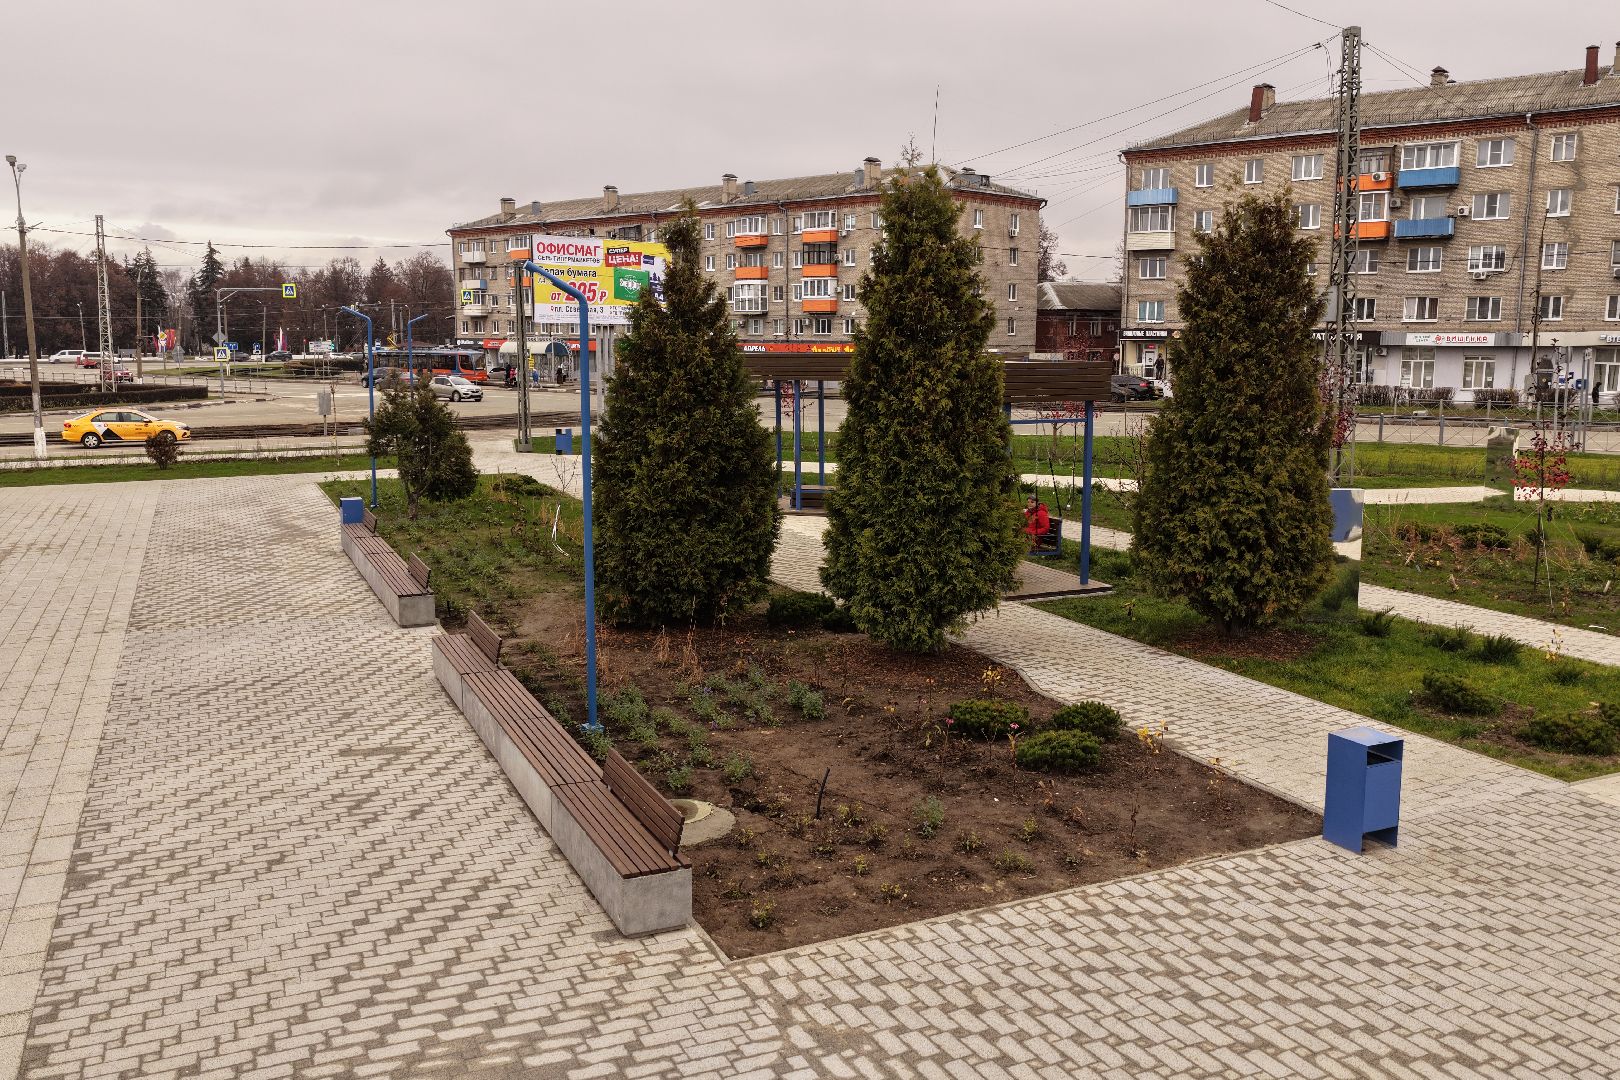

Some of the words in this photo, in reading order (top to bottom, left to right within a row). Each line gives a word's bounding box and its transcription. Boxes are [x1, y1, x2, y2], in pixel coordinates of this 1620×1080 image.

[536, 241, 601, 257] ОФИСМАГ
[608, 254, 639, 264] ЦЕНА!
[566, 267, 597, 278] бумага
[1445, 335, 1489, 344] ВИШЕНКА
